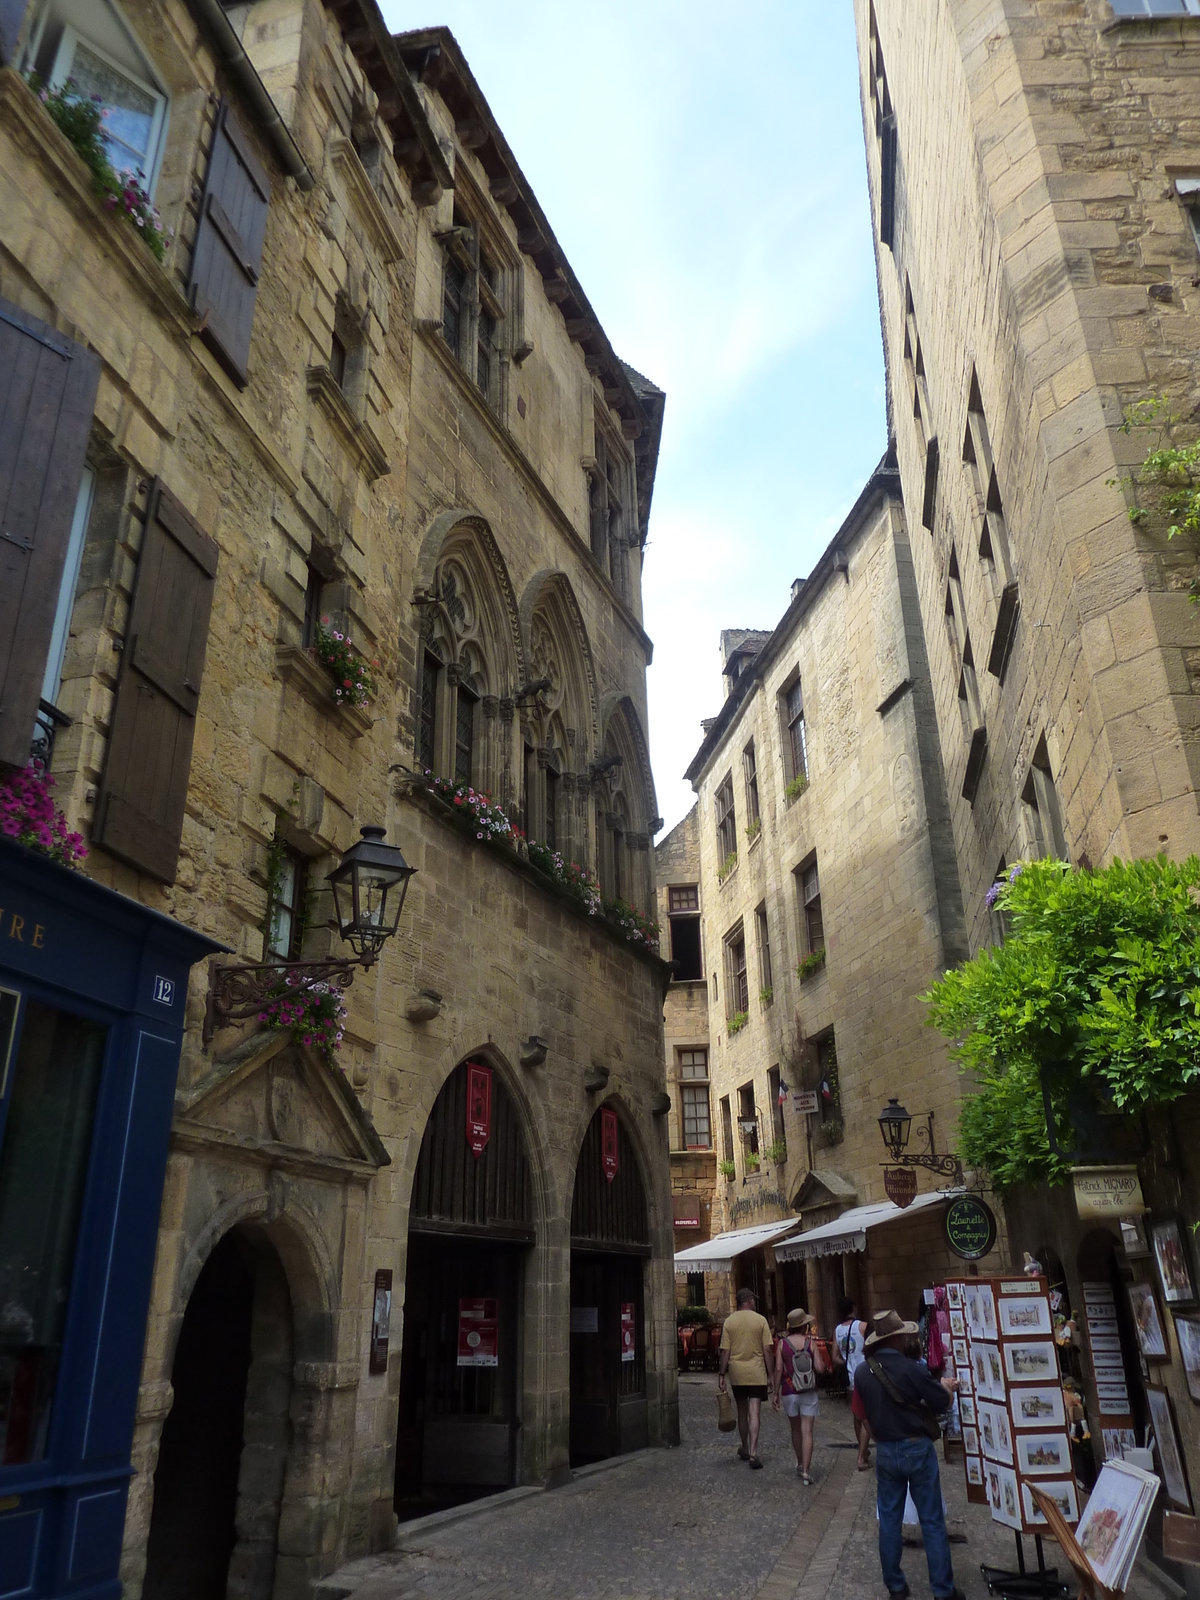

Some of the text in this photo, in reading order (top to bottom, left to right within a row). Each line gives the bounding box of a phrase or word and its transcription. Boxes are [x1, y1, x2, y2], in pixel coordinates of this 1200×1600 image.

[0, 907, 46, 949] RE
[157, 979, 172, 1002] 12
[886, 1171, 915, 1183] Auberge
[886, 1184, 918, 1194] Mirandol
[1077, 1177, 1137, 1197] Patrick MIGNARD
[1092, 1193, 1124, 1209] aquarelle
[950, 1211, 985, 1225] Laurette
[952, 1230, 987, 1242] Compagnie
[783, 1249, 806, 1260] Auberge
[823, 1237, 856, 1253] Mirandol
